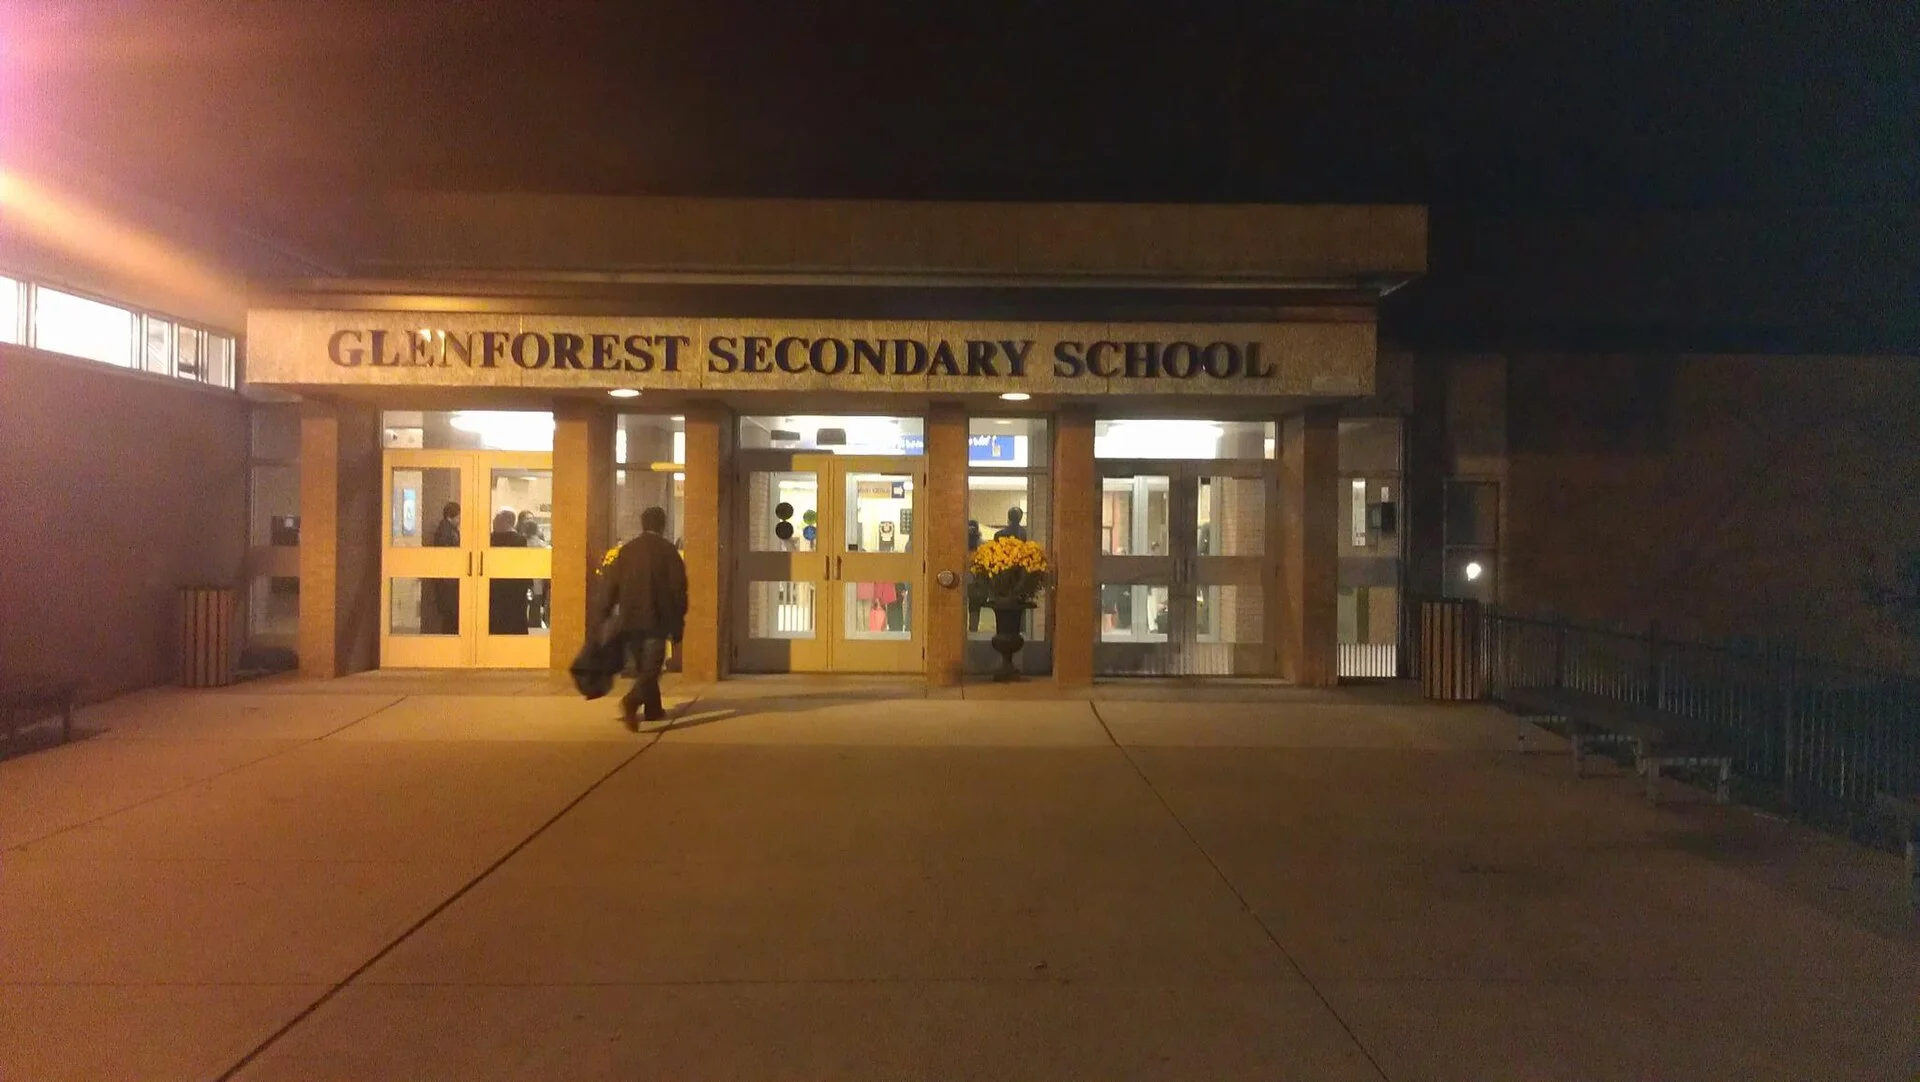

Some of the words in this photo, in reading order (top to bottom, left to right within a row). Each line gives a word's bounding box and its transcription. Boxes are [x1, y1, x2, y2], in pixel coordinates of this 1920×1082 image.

[327, 328, 690, 372] GLENFOREST
[708, 335, 1035, 377] SECONDARY
[1053, 340, 1278, 379] SCHOOL
